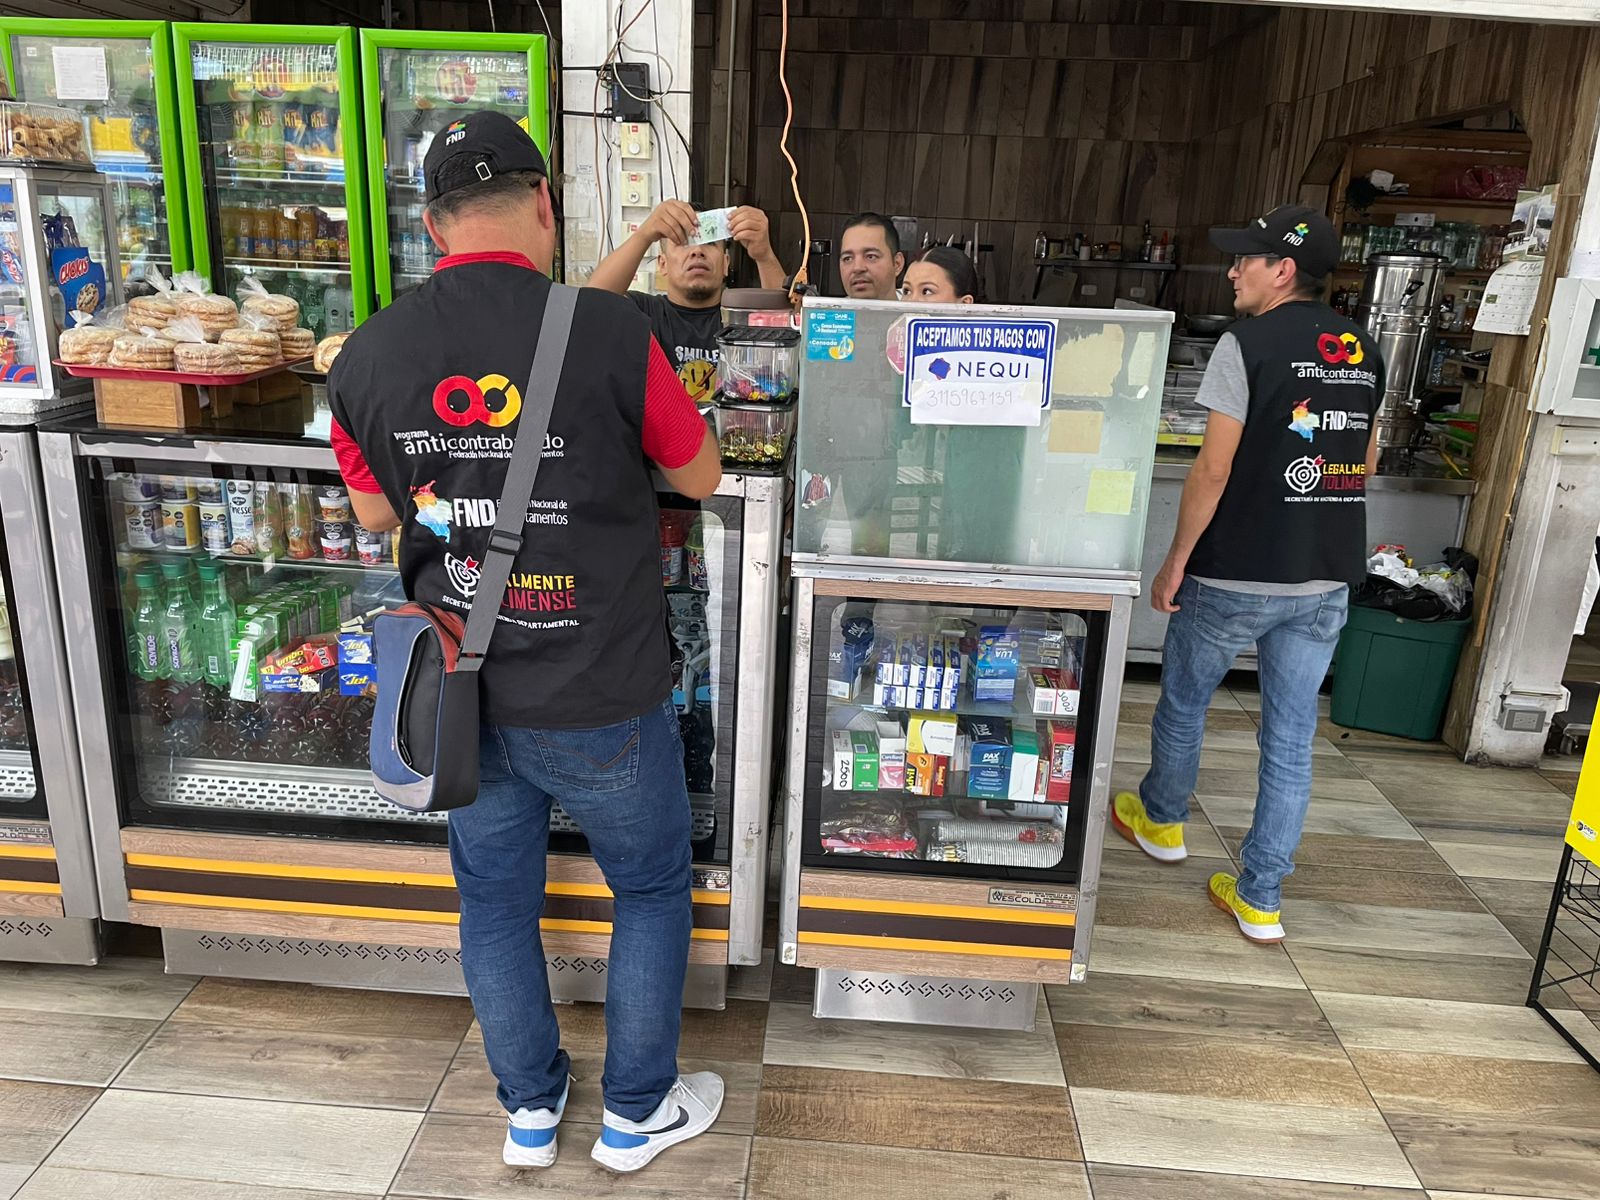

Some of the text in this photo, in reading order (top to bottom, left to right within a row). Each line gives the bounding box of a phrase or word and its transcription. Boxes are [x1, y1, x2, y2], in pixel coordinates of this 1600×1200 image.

[445, 131, 466, 146] FND
[1282, 232, 1304, 247] FND
[59, 257, 89, 285] CHOKIS
[916, 327, 971, 348] ACEPTAMOS
[973, 328, 991, 348] TUS
[993, 329, 1024, 349] PAGOS
[1025, 329, 1046, 349] CON
[957, 361, 1029, 378] NEQUI
[1322, 410, 1347, 431] FND
[394, 430, 429, 441] Programa
[404, 432, 564, 455] anticontrabdo
[478, 450, 501, 459] Nacional
[503, 450, 512, 459] de
[531, 500, 567, 509] Nacional de
[453, 498, 496, 528] FND
[346, 676, 368, 685] Jet
[983, 752, 1000, 760] PAX
[839, 759, 851, 788] 2500
